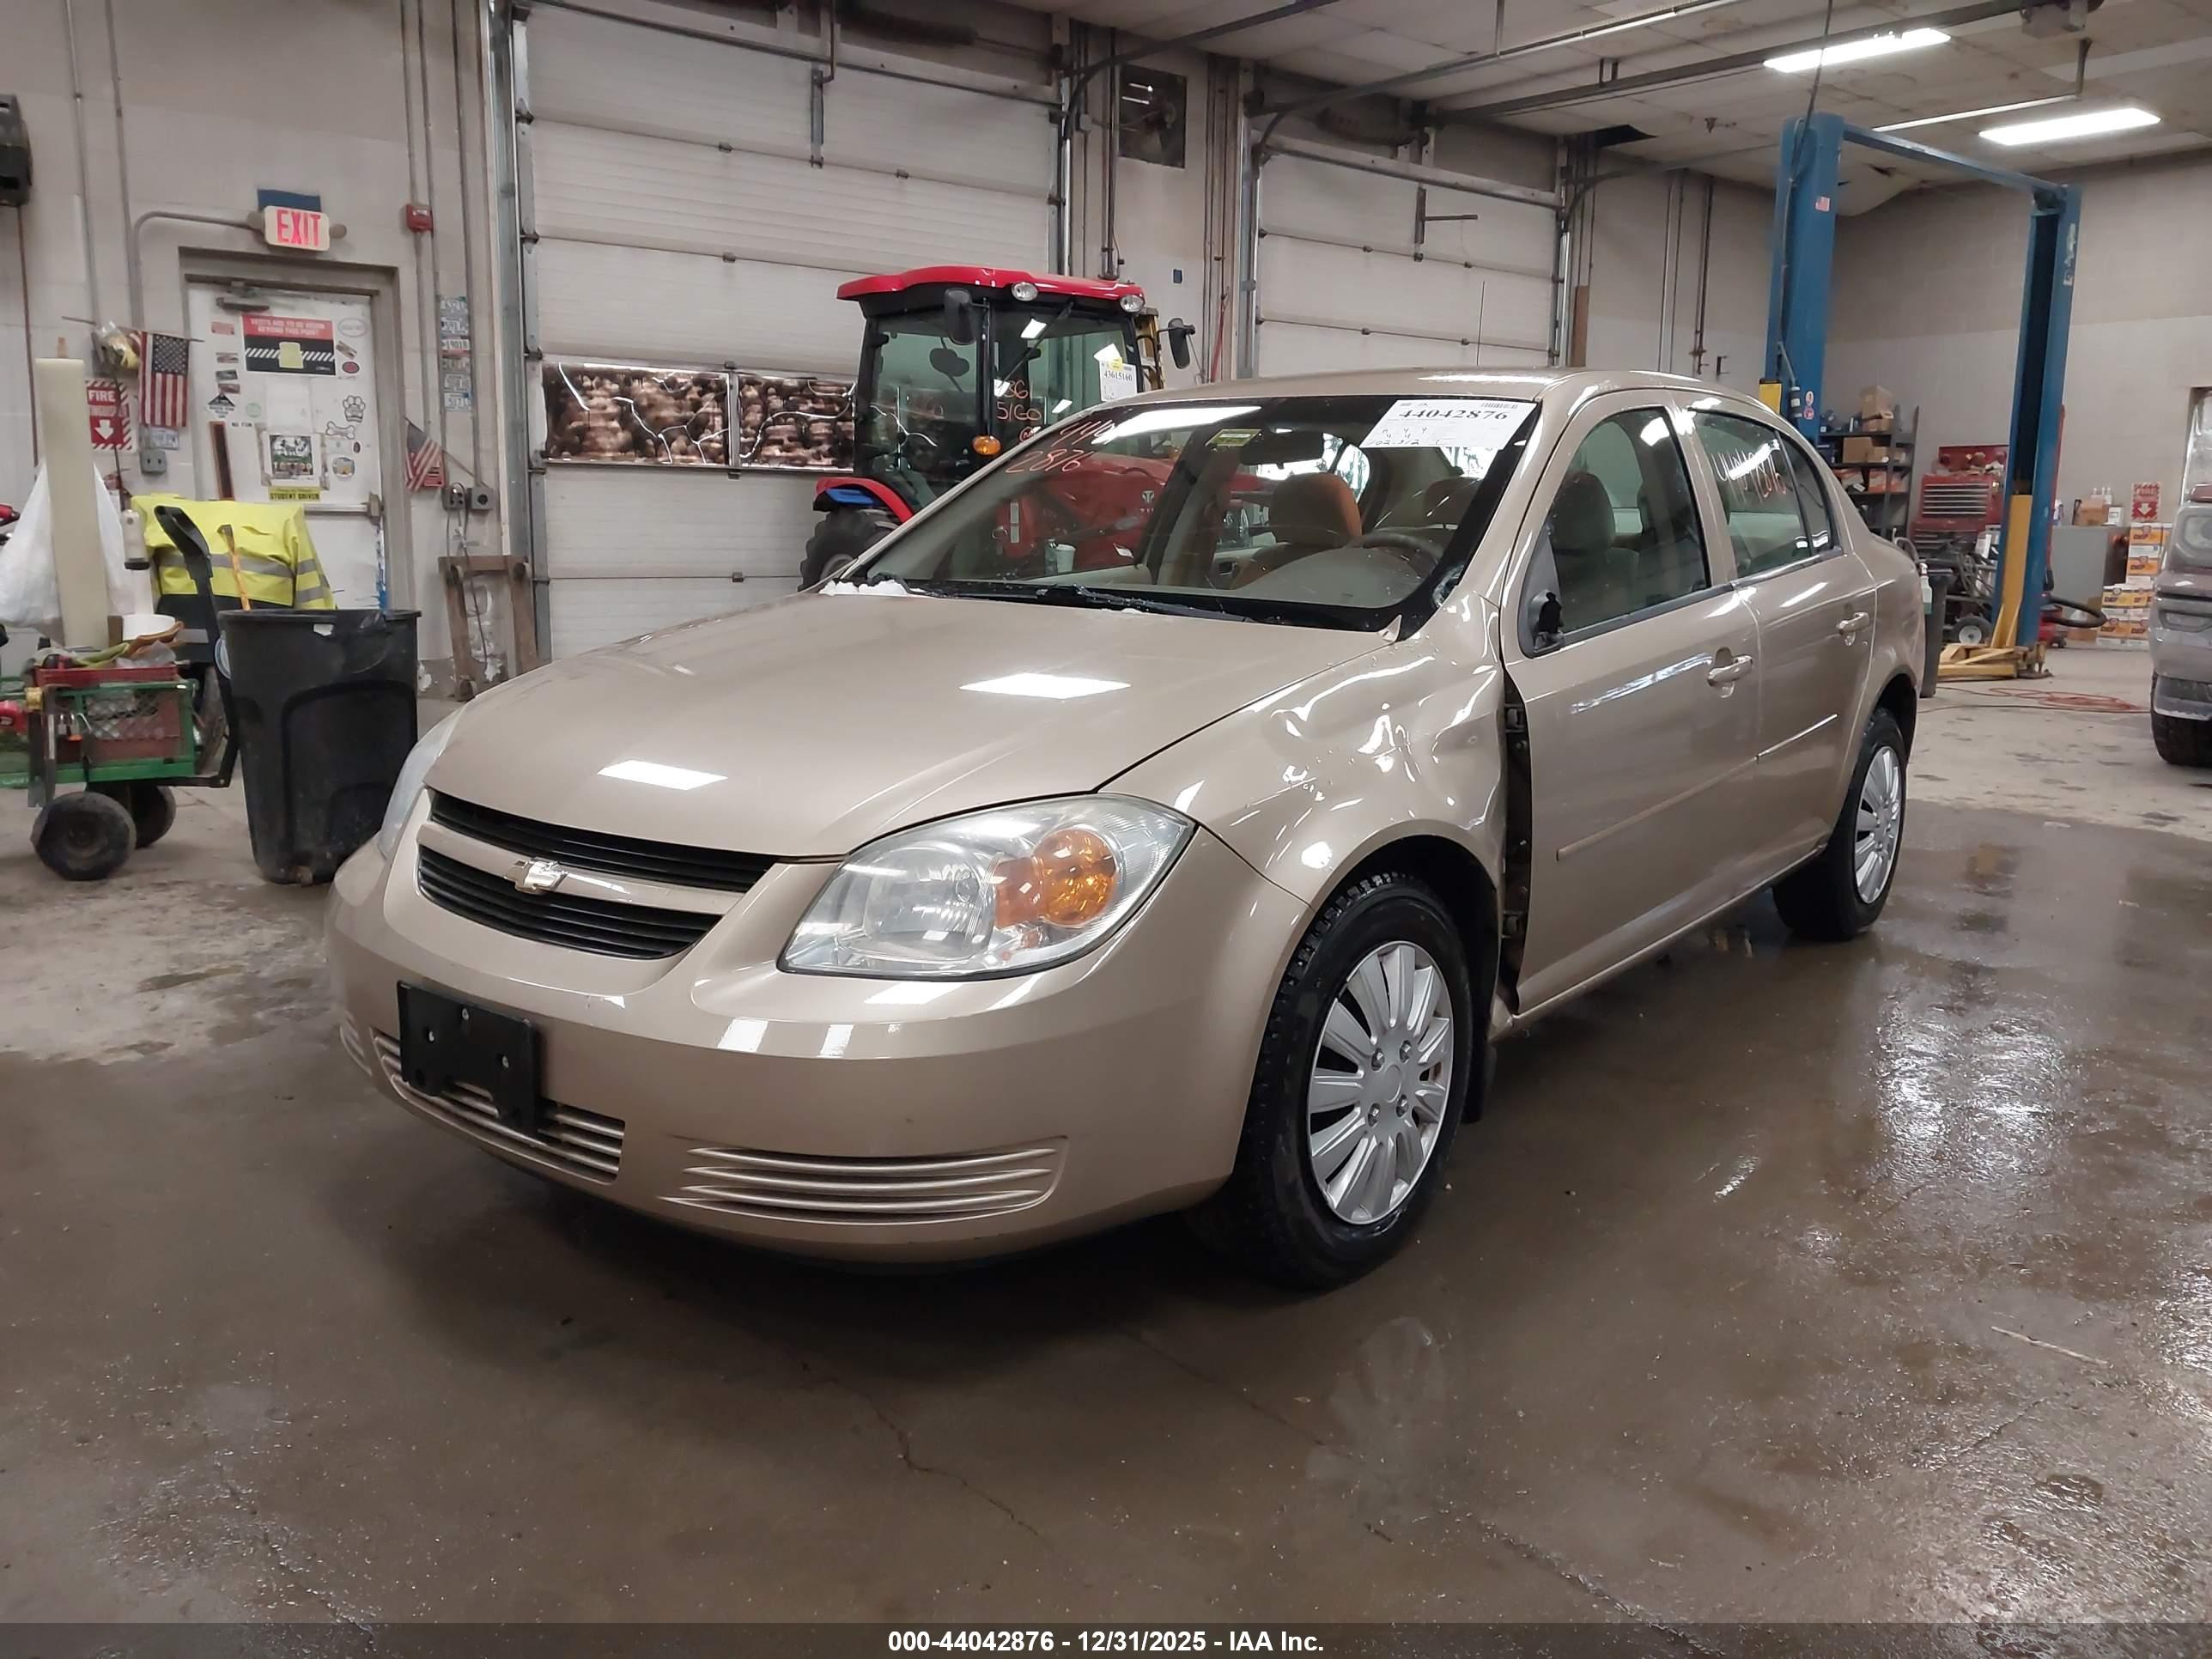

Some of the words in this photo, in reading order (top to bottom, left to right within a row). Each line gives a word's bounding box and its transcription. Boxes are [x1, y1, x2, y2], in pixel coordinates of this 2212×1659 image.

[276, 209, 321, 248] EXIT
[88, 389, 116, 403] FIRE
[1399, 409, 1509, 421] 44042876
[1006, 448, 1095, 472] 2876
